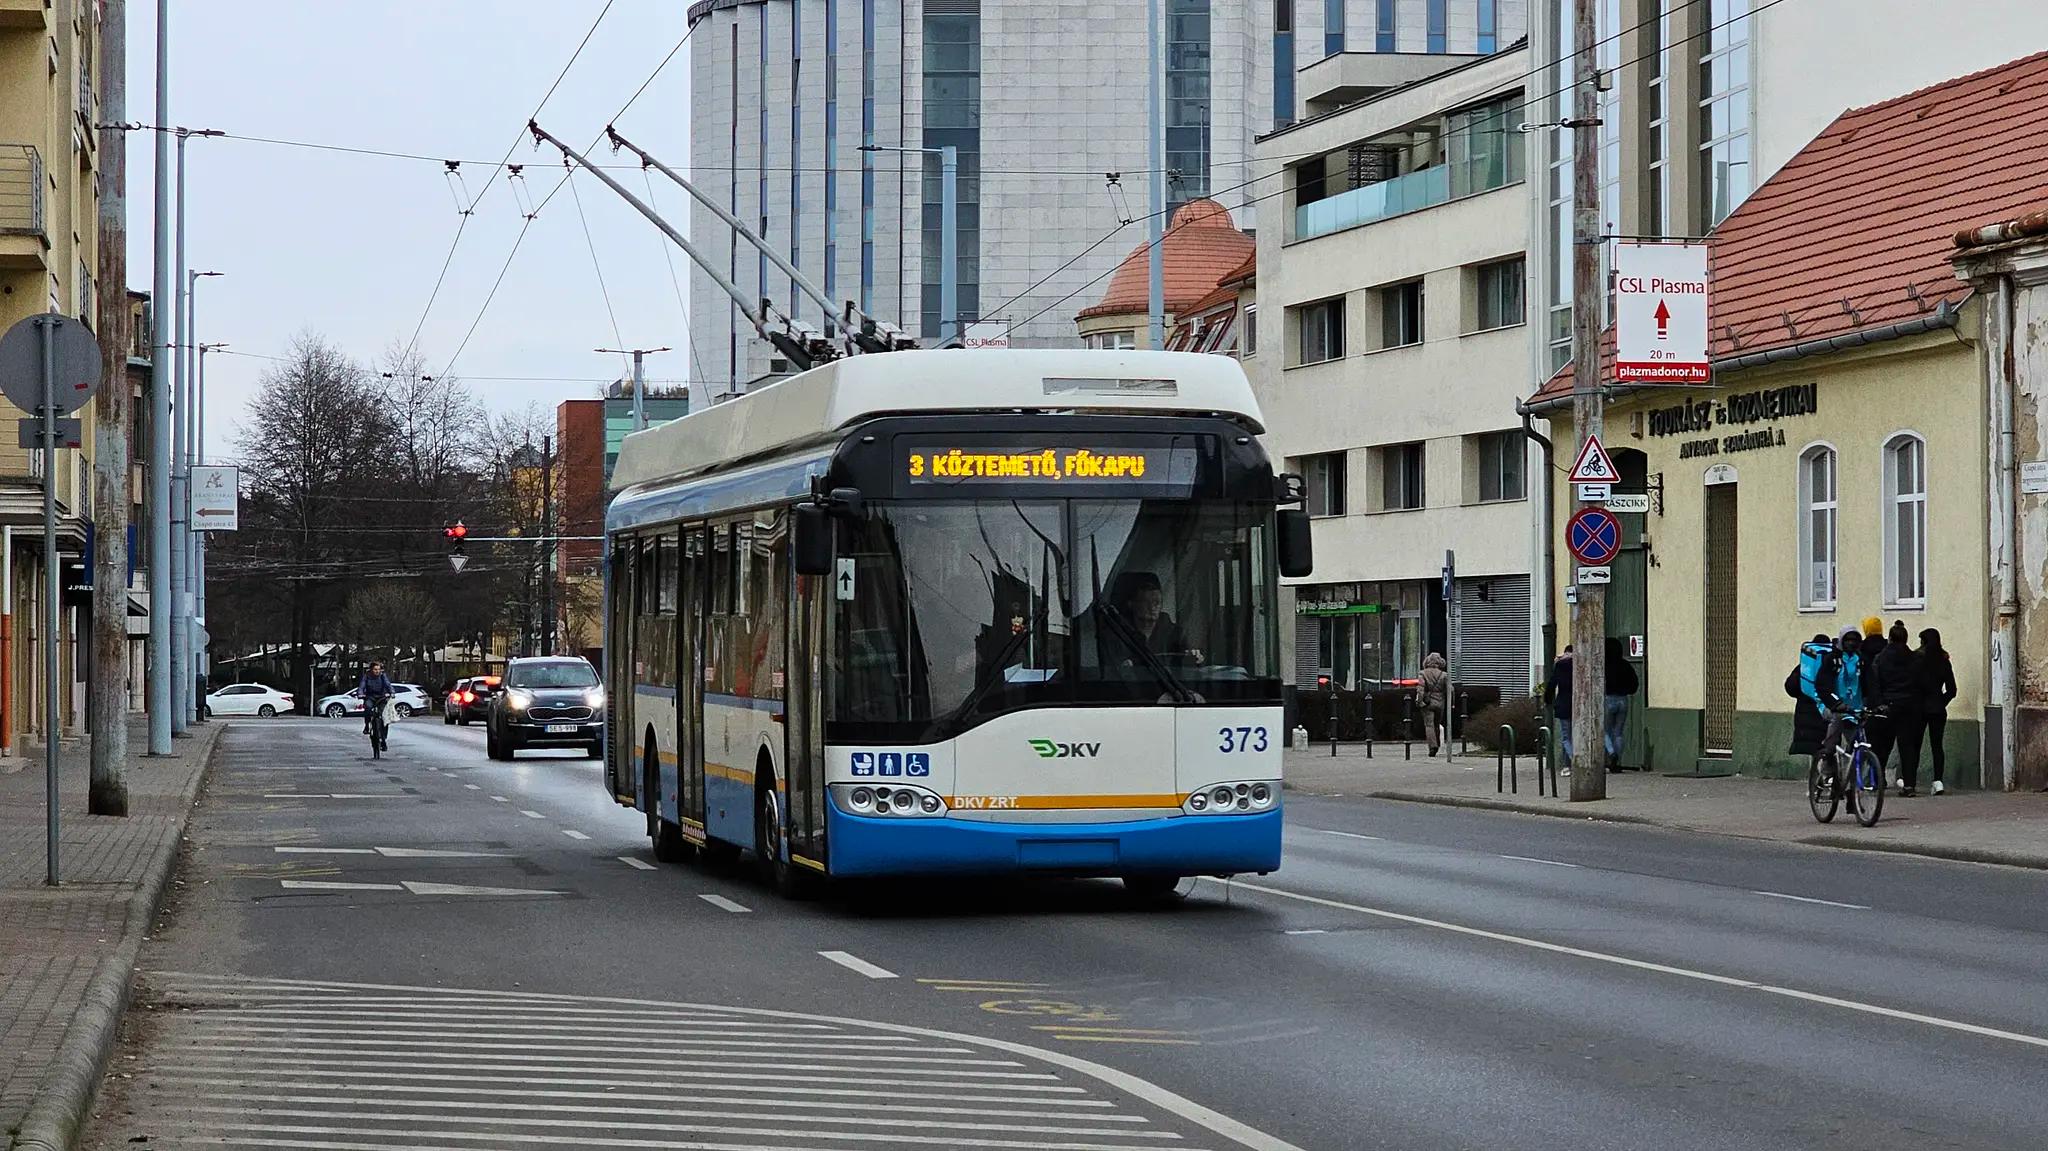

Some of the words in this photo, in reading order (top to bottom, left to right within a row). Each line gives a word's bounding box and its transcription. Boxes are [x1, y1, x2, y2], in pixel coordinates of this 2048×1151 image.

[1619, 278, 1646, 293] CSL
[1651, 278, 1705, 294] Plasma
[966, 338, 979, 347] CSL
[1650, 350, 1663, 360] 20
[1665, 352, 1676, 360] m
[1619, 366, 1706, 378] plazmadonor.hu
[909, 455, 925, 476] 3
[1065, 450, 1145, 477] FŐKAPU
[1604, 497, 1646, 507] RÁSZCIKK
[1219, 727, 1268, 752] 373
[954, 797, 985, 809] DKV
[989, 797, 1020, 808] ZRT.
